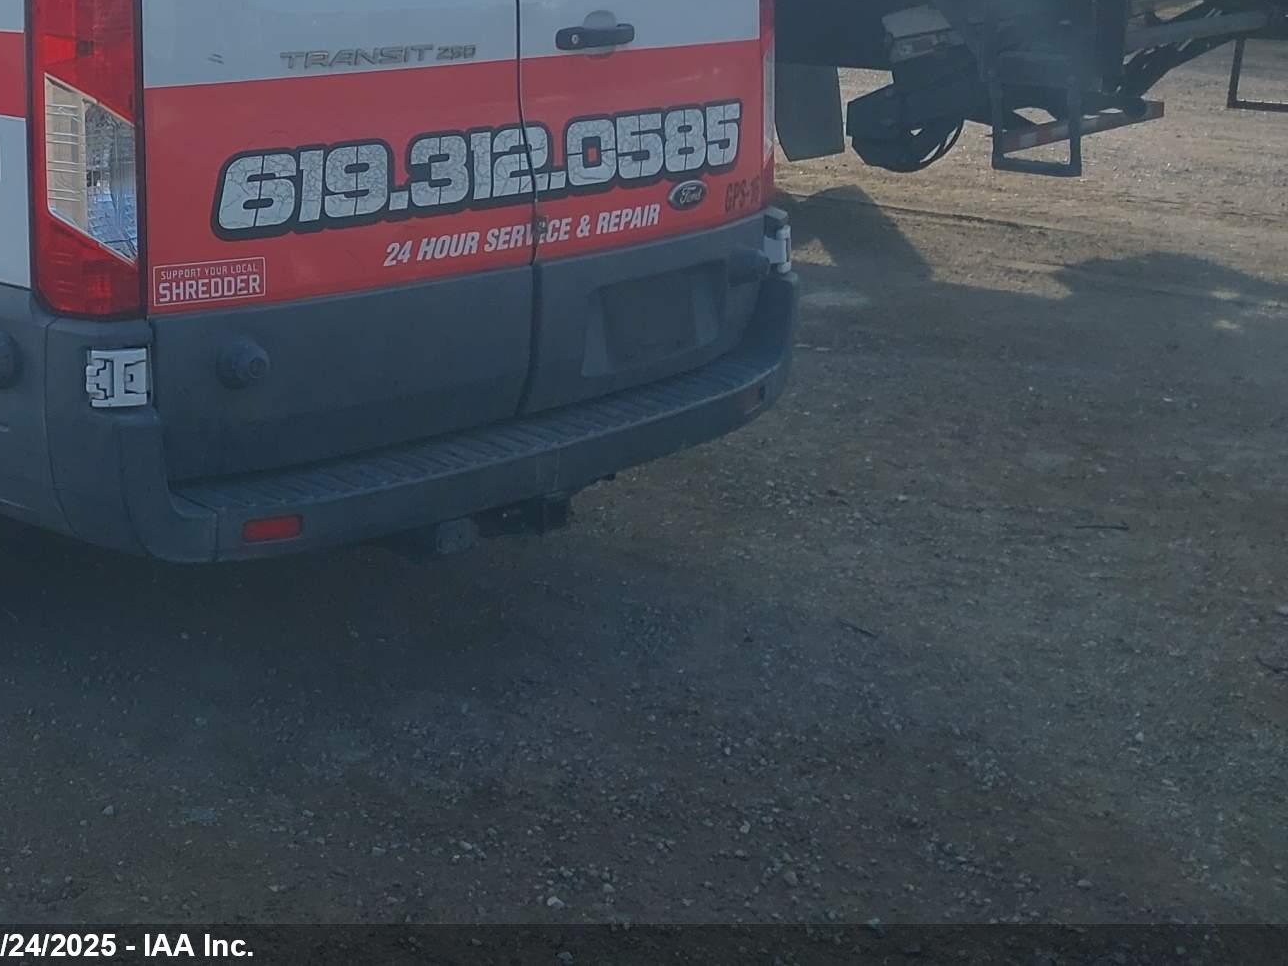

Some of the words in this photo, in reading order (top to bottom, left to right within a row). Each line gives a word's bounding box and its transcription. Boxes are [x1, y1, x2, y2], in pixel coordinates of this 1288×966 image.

[280, 43, 434, 70] TRANSIT
[216, 102, 739, 233] 619.312.0585
[679, 186, 703, 204] Ford
[384, 241, 411, 267] 24
[416, 233, 479, 261] HOUR
[576, 214, 591, 237] &
[595, 203, 660, 234] REPAIR
[161, 267, 201, 280] SUPPORT
[204, 265, 227, 276] YOUR
[231, 263, 258, 274] LOCAL
[158, 274, 261, 302] SHREDDER
